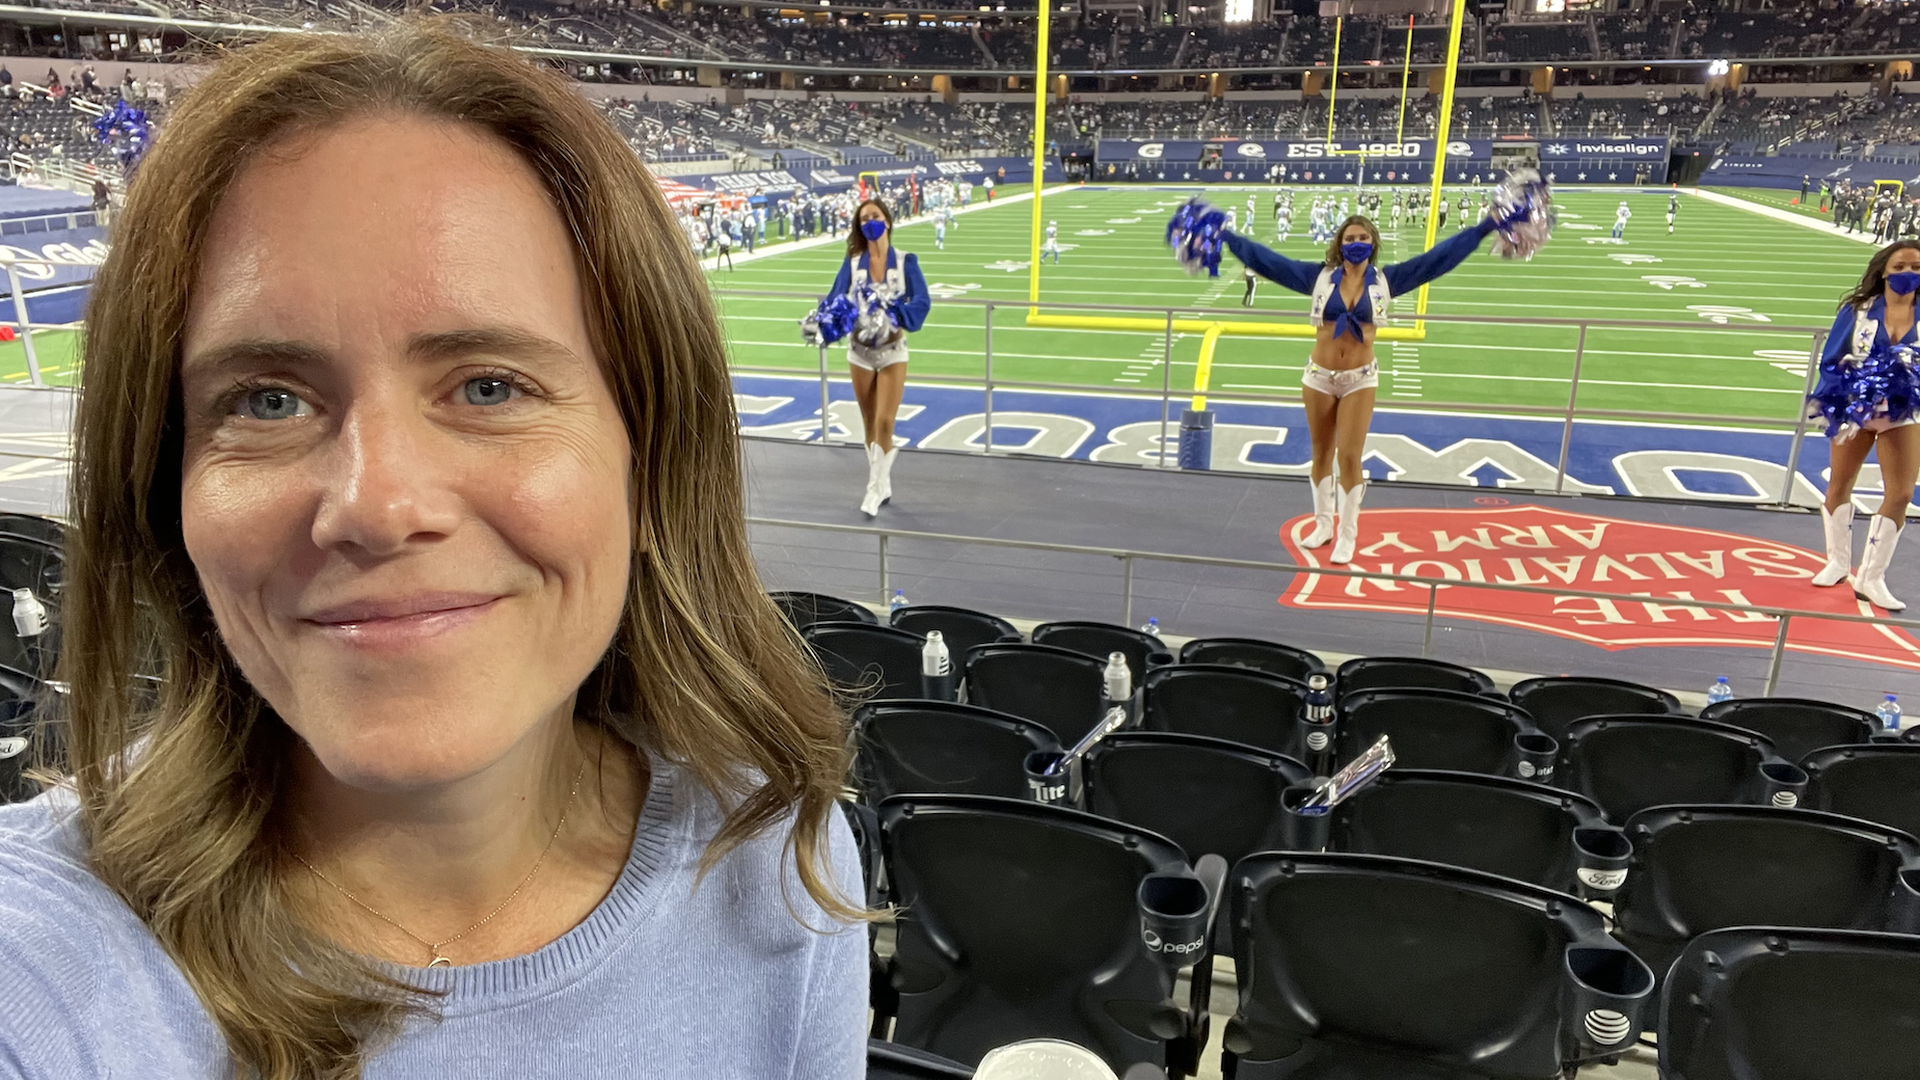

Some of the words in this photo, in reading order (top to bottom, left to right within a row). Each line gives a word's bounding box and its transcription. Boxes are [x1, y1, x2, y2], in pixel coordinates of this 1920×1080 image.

[1287, 143, 1345, 157] EST.
[1576, 143, 1659, 155] invisalign
[760, 170, 797, 184] YOU
[1357, 521, 1612, 556] ARMY
[1343, 546, 1818, 598] SALVATION
[1553, 588, 1783, 626] THE
[1028, 778, 1065, 803] Lite
[1588, 873, 1624, 885] Ford
[1163, 935, 1204, 954] pepsi
